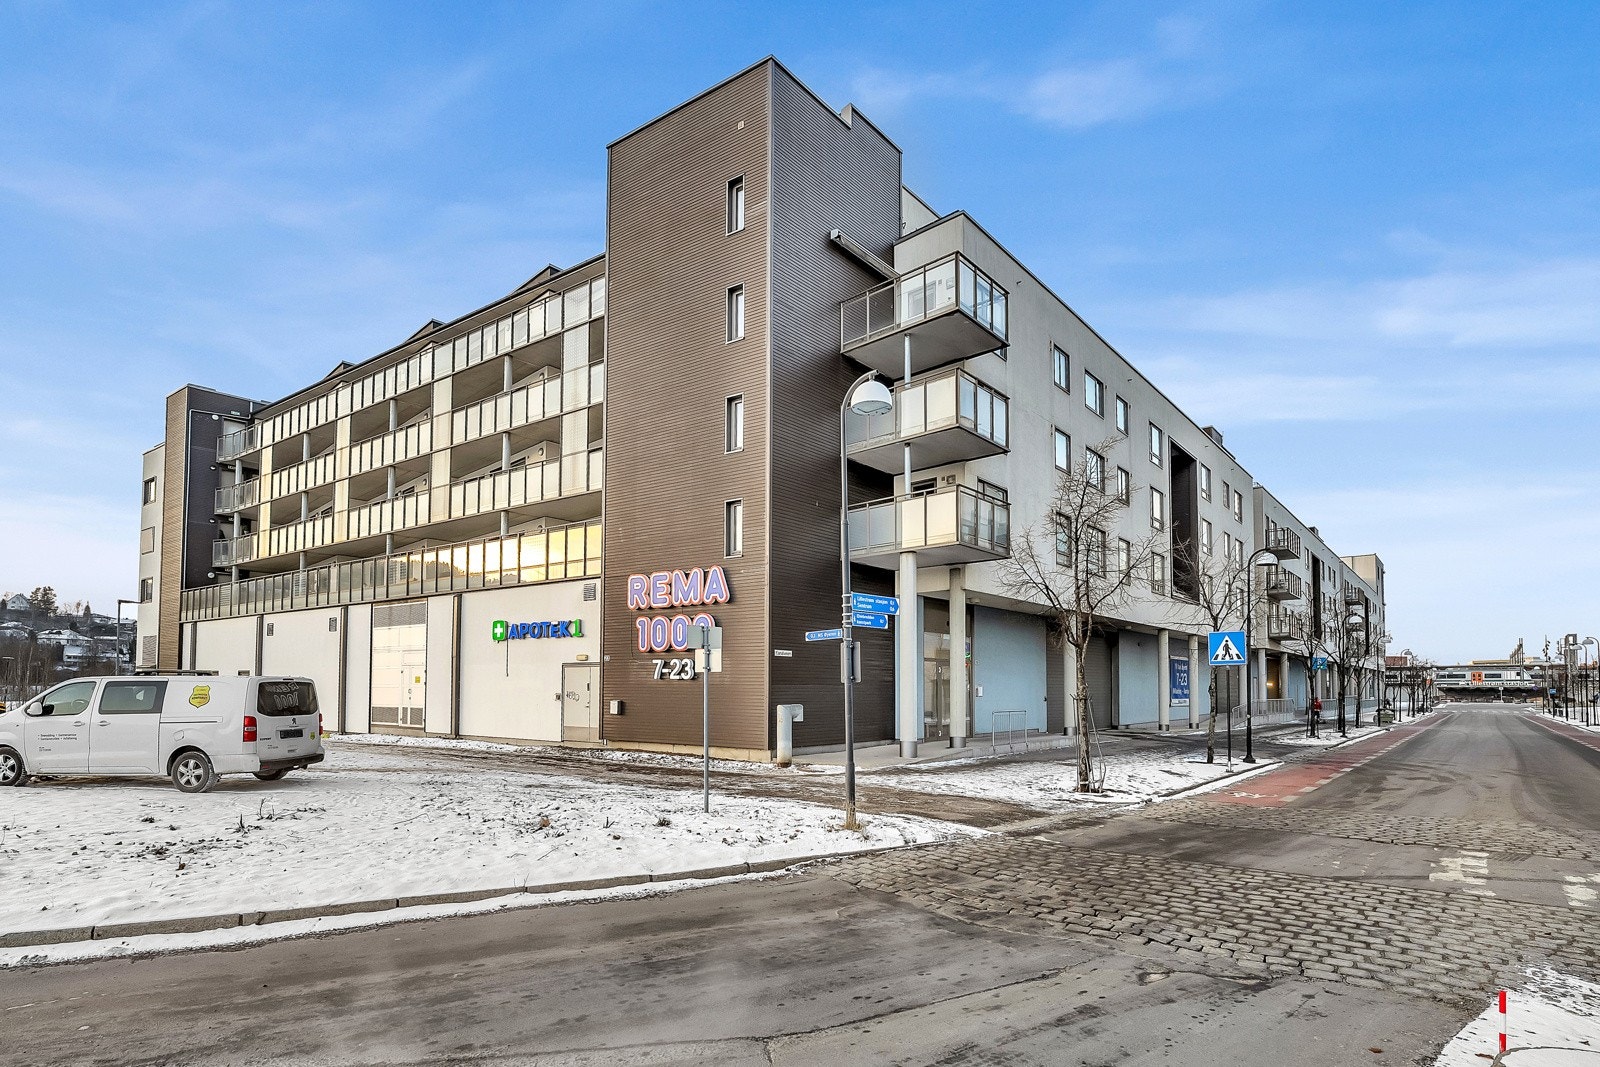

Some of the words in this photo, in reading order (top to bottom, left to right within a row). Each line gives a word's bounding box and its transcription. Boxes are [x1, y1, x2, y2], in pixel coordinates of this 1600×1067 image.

[628, 565, 729, 611] REMA
[510, 620, 571, 640] APOTEK
[652, 658, 695, 680] 7-23
[1176, 673, 1188, 686] 7-23
